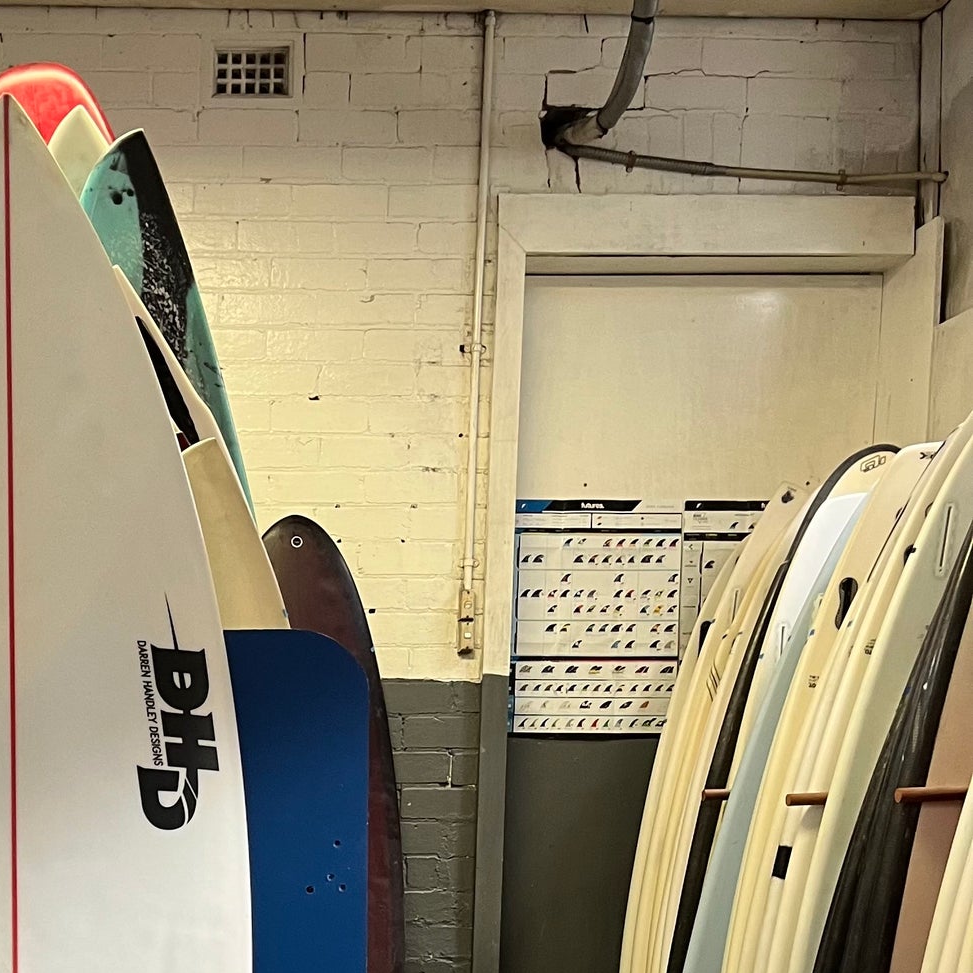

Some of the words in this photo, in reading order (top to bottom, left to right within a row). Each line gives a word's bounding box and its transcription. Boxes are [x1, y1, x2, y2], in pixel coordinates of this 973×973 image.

[137, 640, 151, 678] DARREN
[142, 680, 158, 724] HANDLEY
[149, 726, 163, 767] DESIGNS
